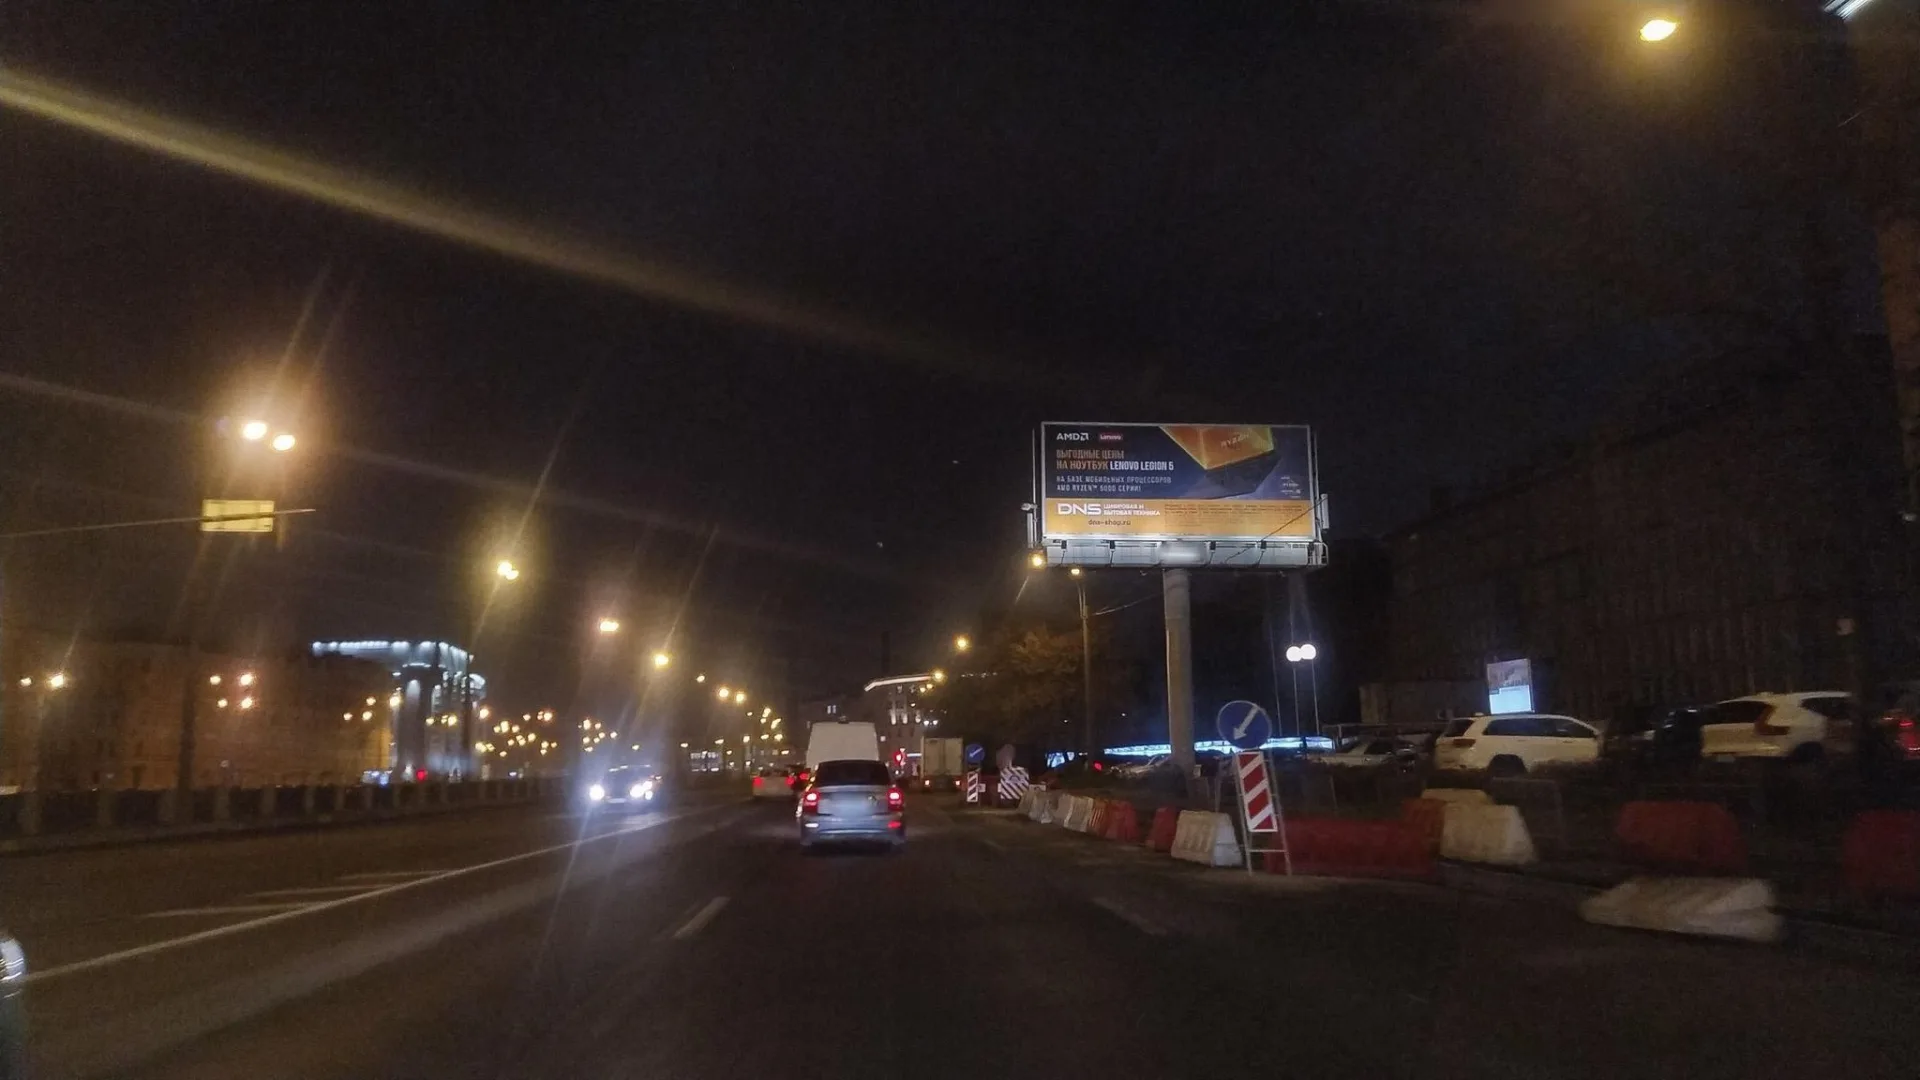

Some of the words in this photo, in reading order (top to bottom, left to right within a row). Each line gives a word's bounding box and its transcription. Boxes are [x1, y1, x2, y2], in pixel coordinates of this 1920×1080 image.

[1056, 433, 1081, 441] AMD
[1056, 450, 1099, 459] ВЫГОДНЫЕ
[1102, 450, 1124, 459] ЦЕНЫ
[1056, 460, 1069, 470] НА
[1070, 460, 1109, 470] НОУТБУК
[1110, 461, 1139, 470] LENOVO
[1140, 461, 1167, 470] LEGION
[1086, 475, 1124, 483] МОБИЛЬНЫХ
[1126, 476, 1172, 484] ПРОЦЕССОРОВ
[1057, 503, 1101, 515] DNS
